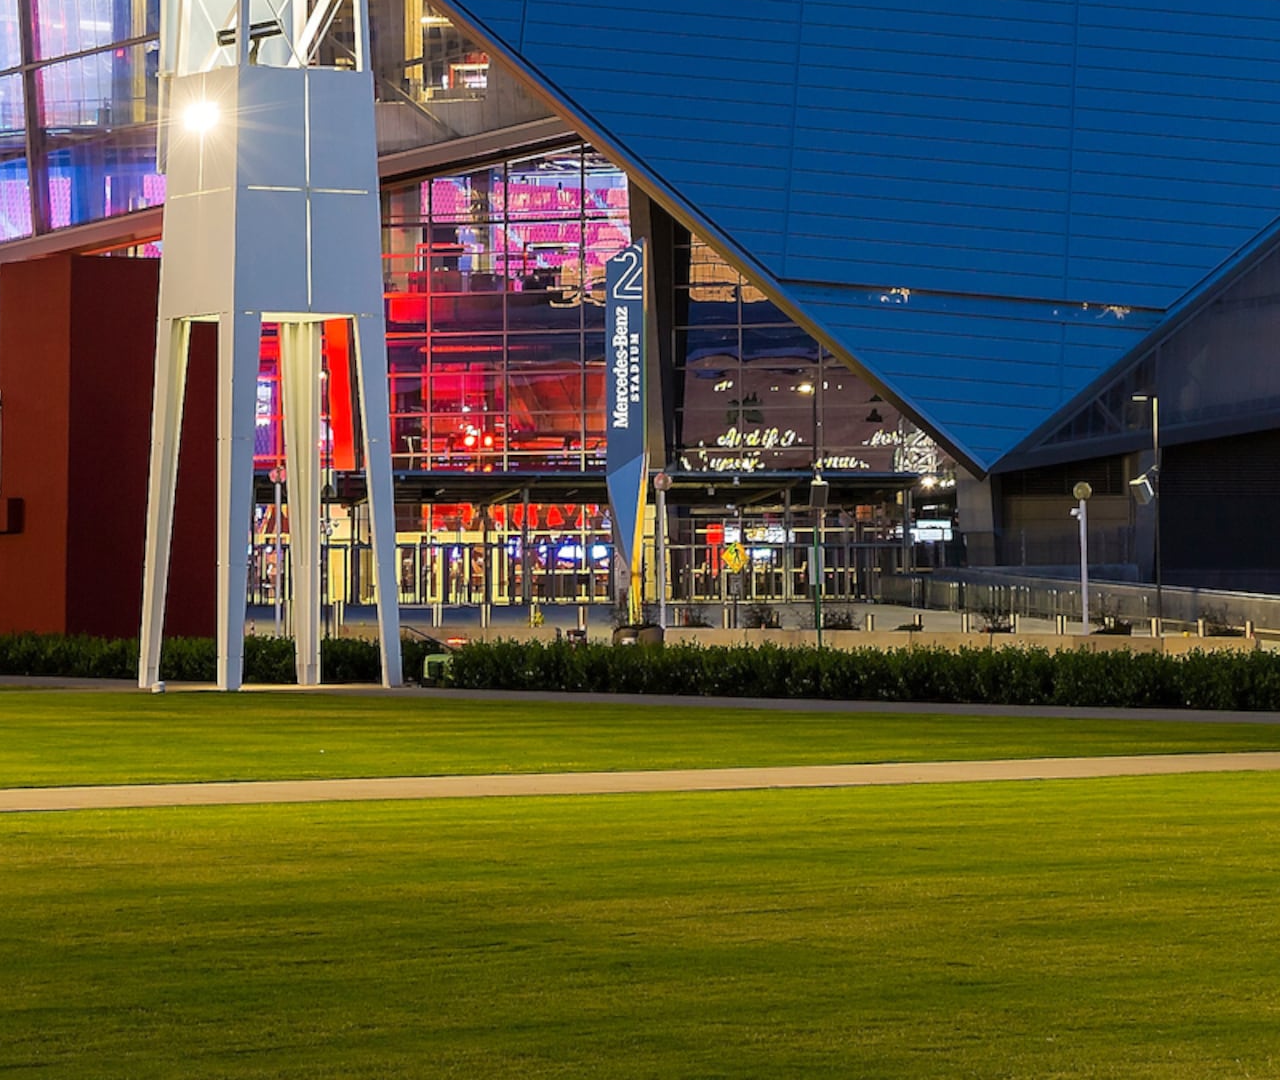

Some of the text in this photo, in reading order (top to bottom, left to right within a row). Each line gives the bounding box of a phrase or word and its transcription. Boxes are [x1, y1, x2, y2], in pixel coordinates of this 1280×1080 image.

[613, 244, 643, 300] 2
[613, 306, 629, 429] Mercedes-Benz
[630, 333, 640, 403] STADIUM
